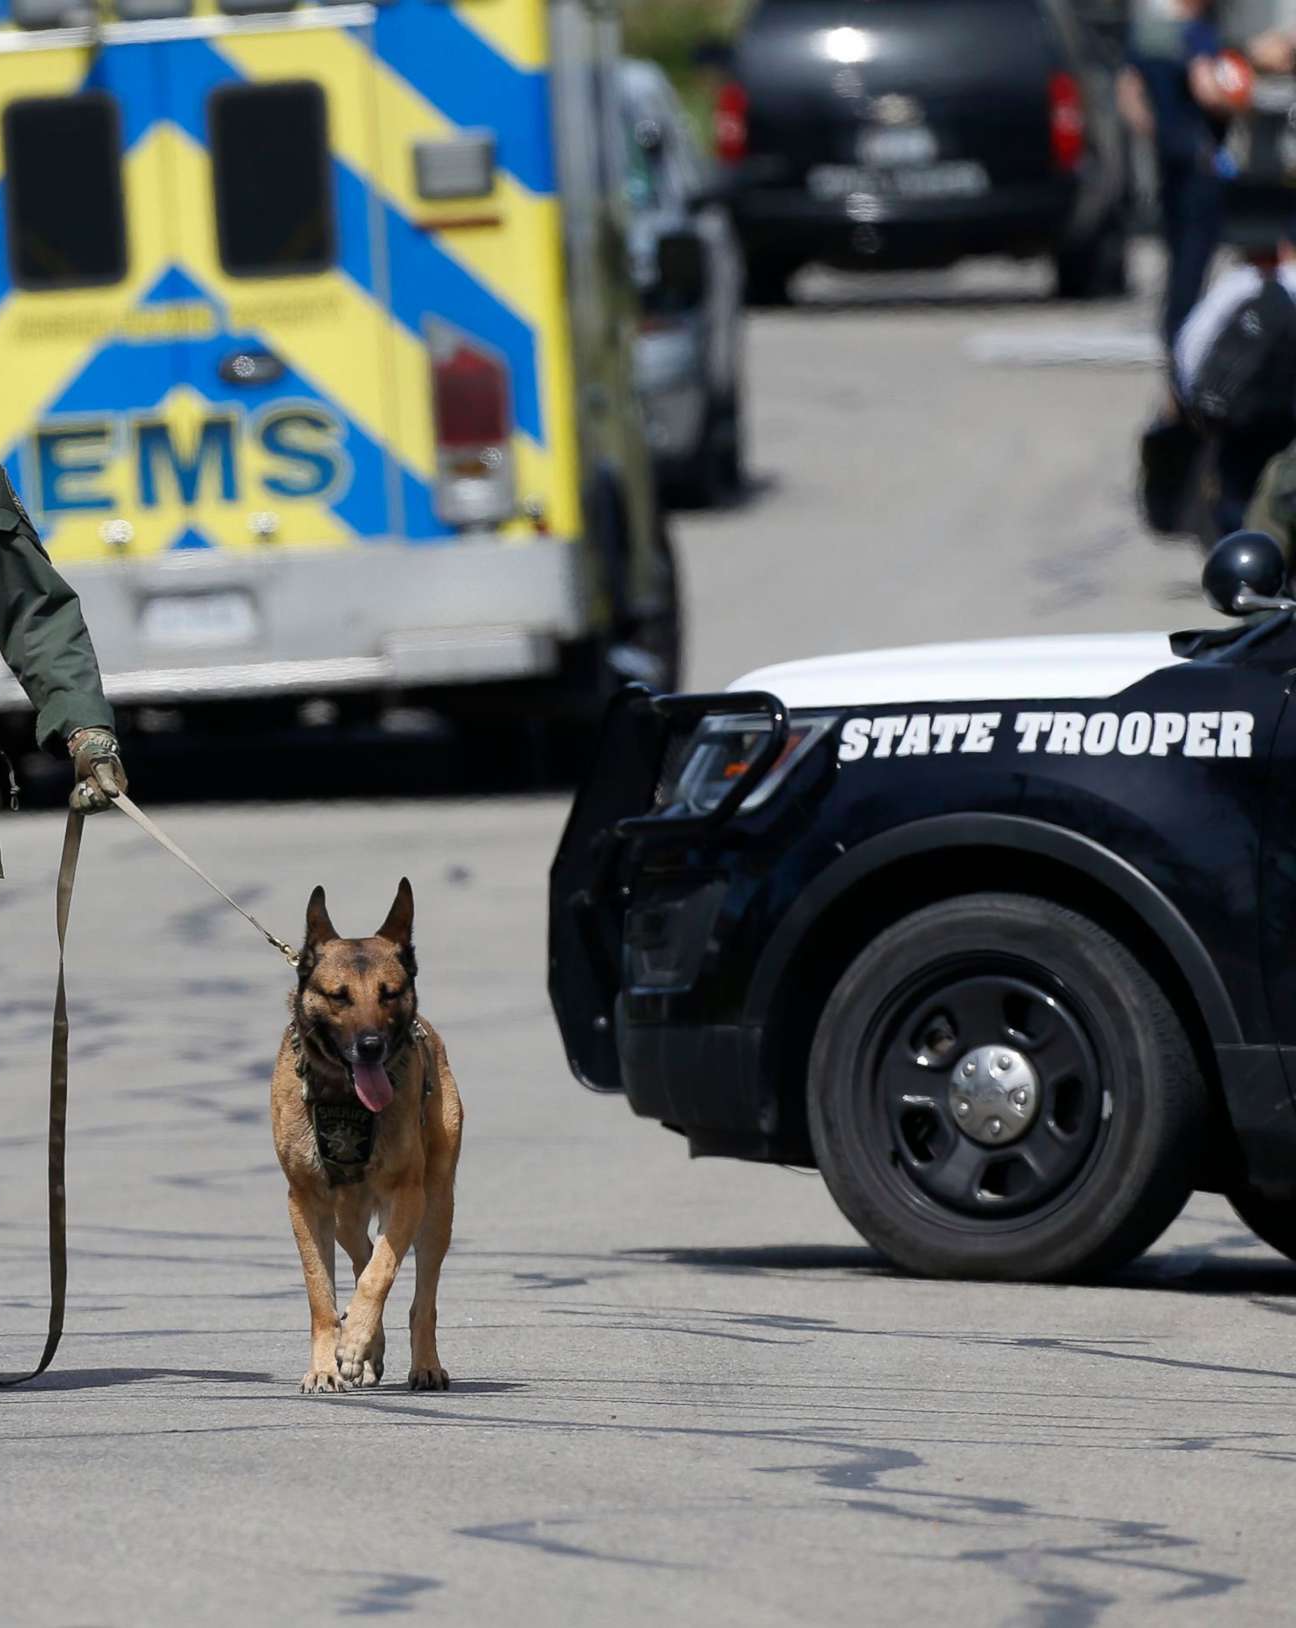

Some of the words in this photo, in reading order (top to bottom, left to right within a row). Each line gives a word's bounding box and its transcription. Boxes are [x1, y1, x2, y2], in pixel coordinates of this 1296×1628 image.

[37, 408, 344, 514] EMS
[837, 711, 1002, 762] STATE
[1014, 711, 1254, 757] TROOPER
